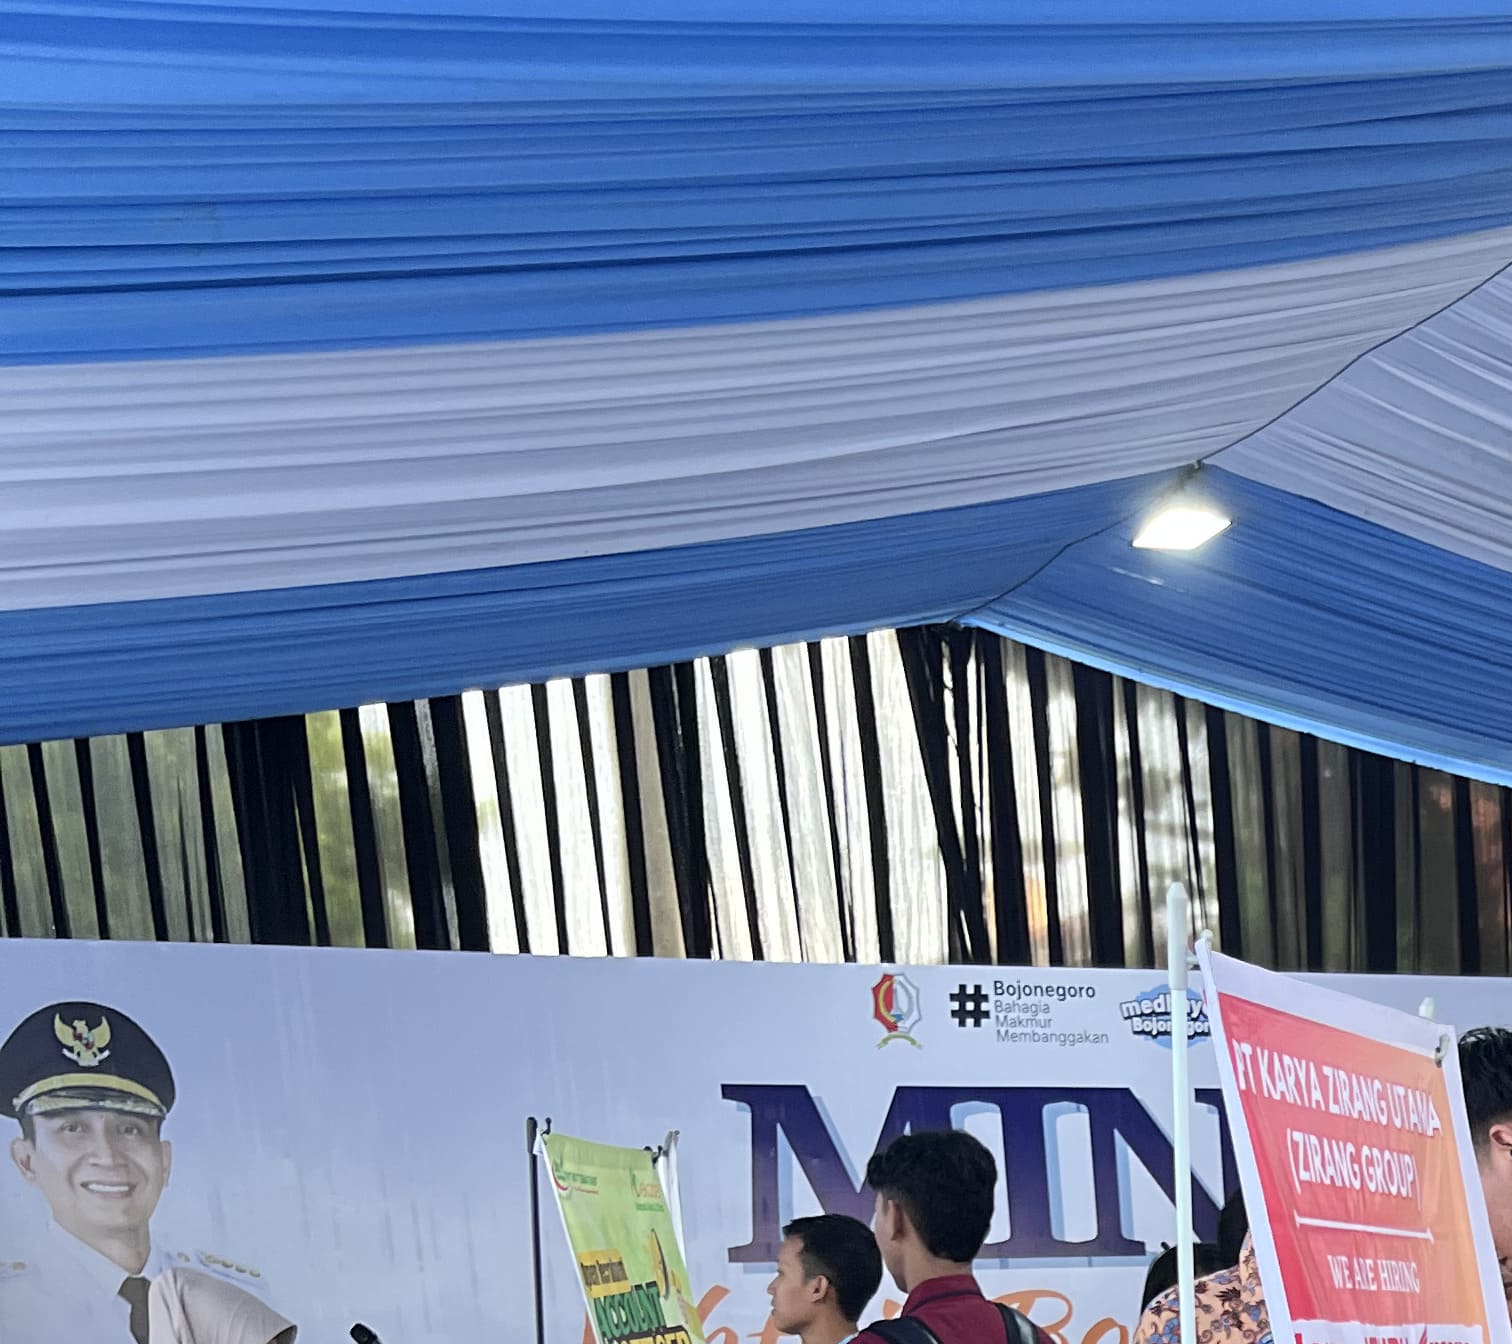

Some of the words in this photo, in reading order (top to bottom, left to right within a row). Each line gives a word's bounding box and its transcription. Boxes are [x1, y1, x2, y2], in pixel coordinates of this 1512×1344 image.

[994, 980, 1096, 1001] Bojonegoro
[994, 1000, 1050, 1016] Bahagia
[995, 1015, 1053, 1029] Makmur
[996, 1029, 1109, 1047] Membanggakan
[1232, 1038, 1257, 1095] PT
[1256, 1047, 1325, 1111] KARYA
[1322, 1065, 1388, 1126] ZIRANG
[1386, 1083, 1443, 1137] UTAMA
[1287, 1128, 1362, 1194] (ZIRANG
[1327, 1254, 1353, 1289] WE
[1353, 1257, 1377, 1291] ARE
[1377, 1259, 1420, 1294] HIRING
[593, 1282, 668, 1344] ACCOUNT
